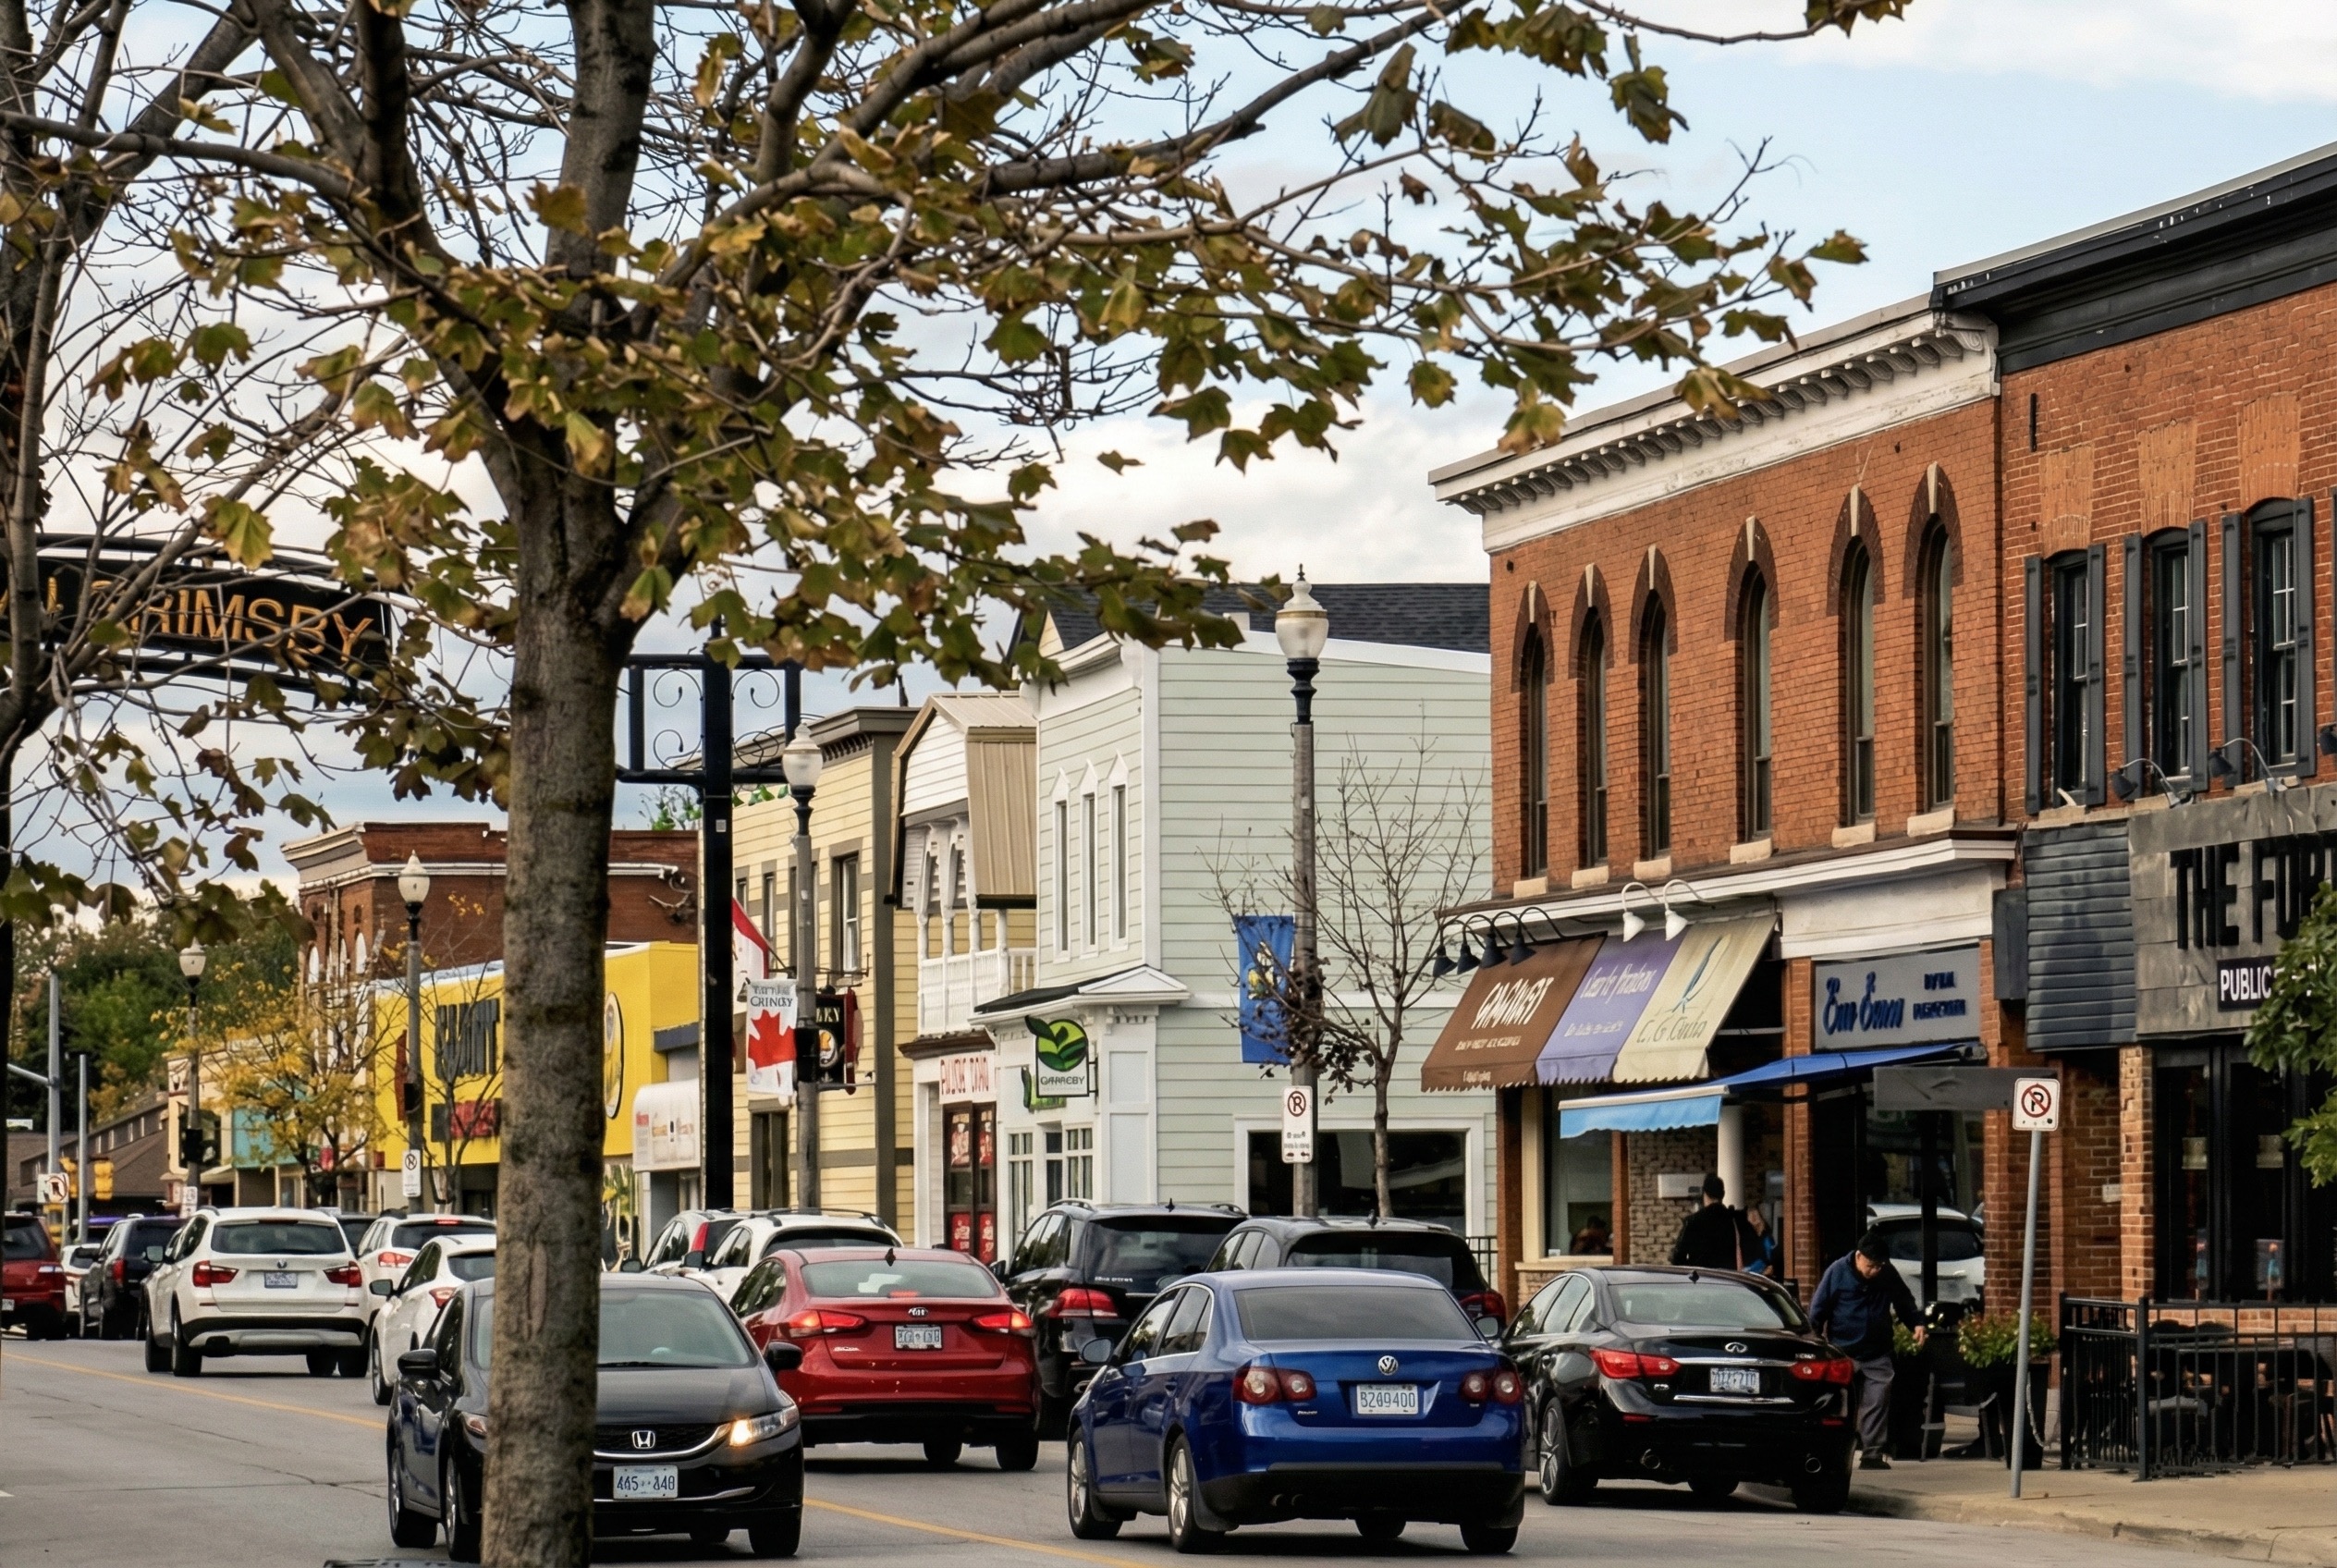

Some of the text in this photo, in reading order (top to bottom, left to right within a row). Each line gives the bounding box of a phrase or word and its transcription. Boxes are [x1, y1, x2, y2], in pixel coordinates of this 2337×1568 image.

[92, 580, 373, 663] RIMSBY
[2170, 845, 2240, 949] THE
[2221, 965, 2272, 1001] PUBLIC
